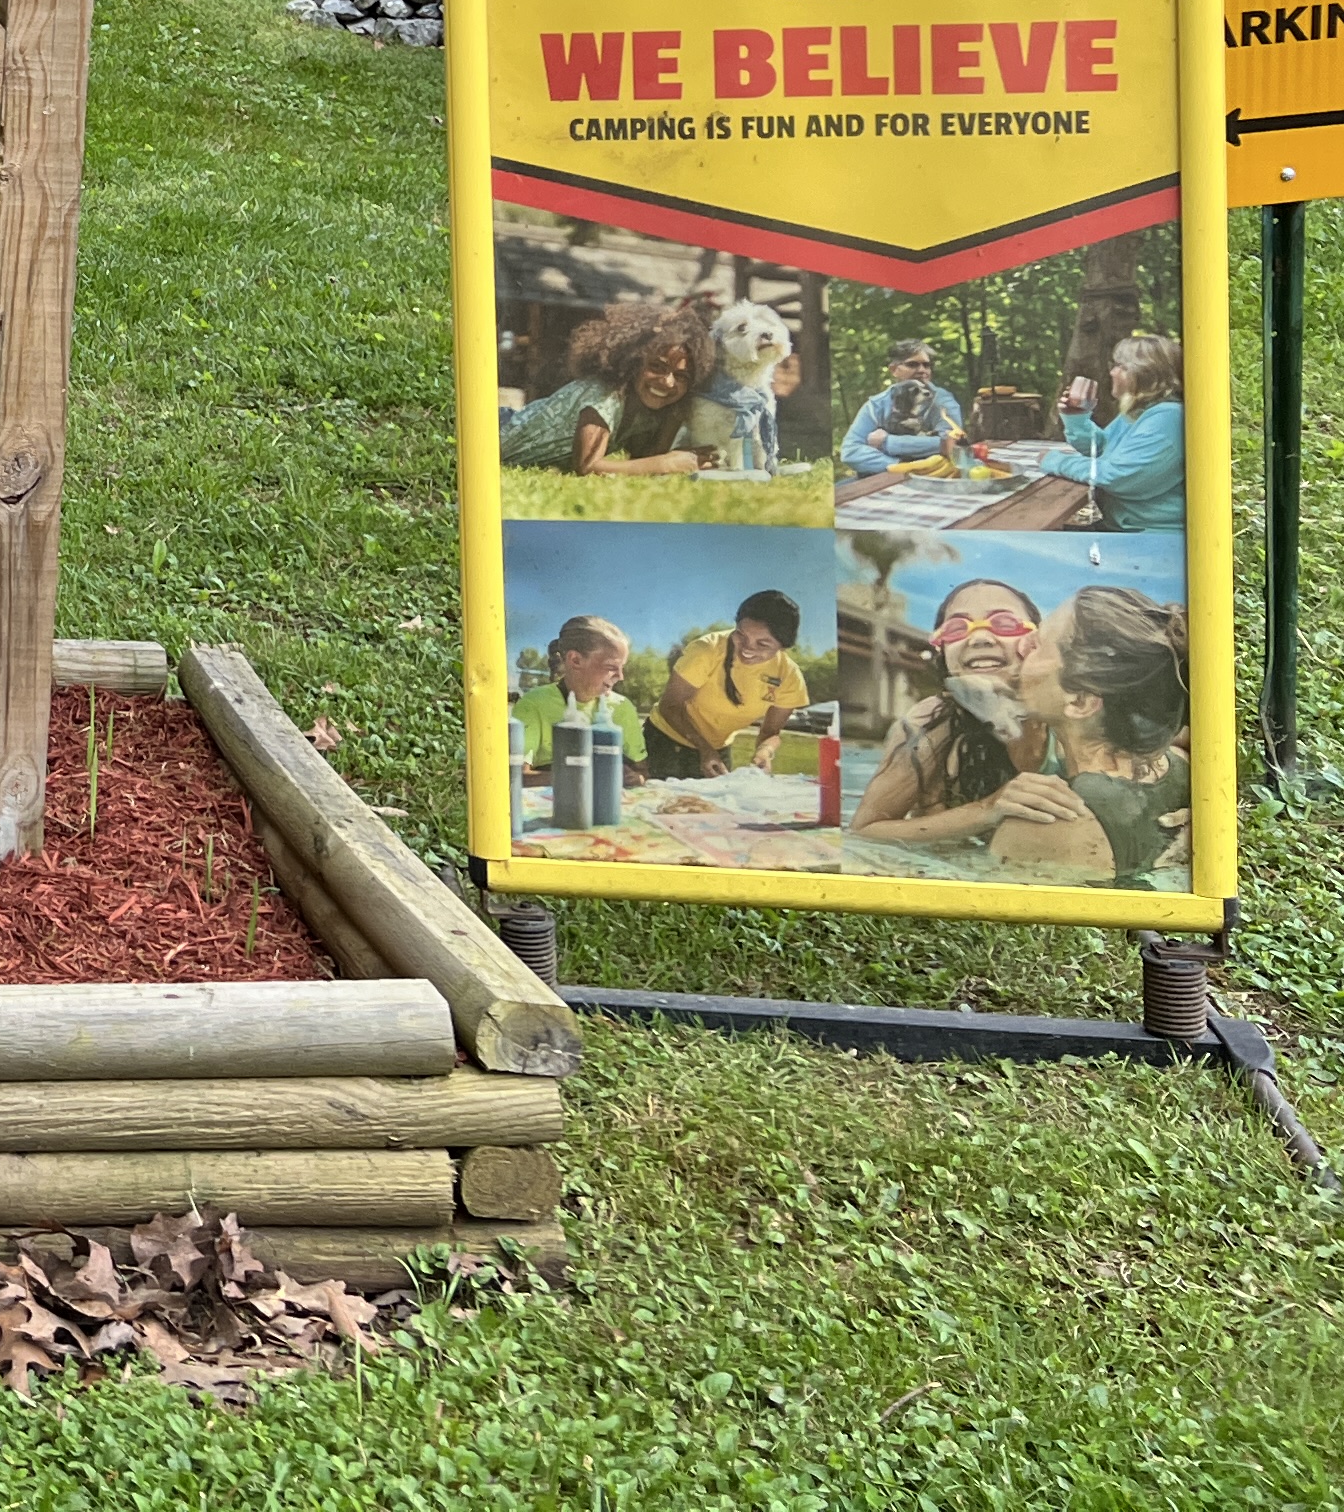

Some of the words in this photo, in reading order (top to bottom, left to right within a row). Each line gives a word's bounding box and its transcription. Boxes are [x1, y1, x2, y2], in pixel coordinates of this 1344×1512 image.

[540, 30, 683, 102] WE
[713, 19, 1119, 99] BELIEVE
[569, 117, 696, 142] CAMPING
[705, 116, 731, 140] IS
[741, 115, 795, 139] FUN
[806, 114, 864, 138] AND
[875, 113, 929, 137] FOR
[941, 110, 1090, 136] EVERYONE
